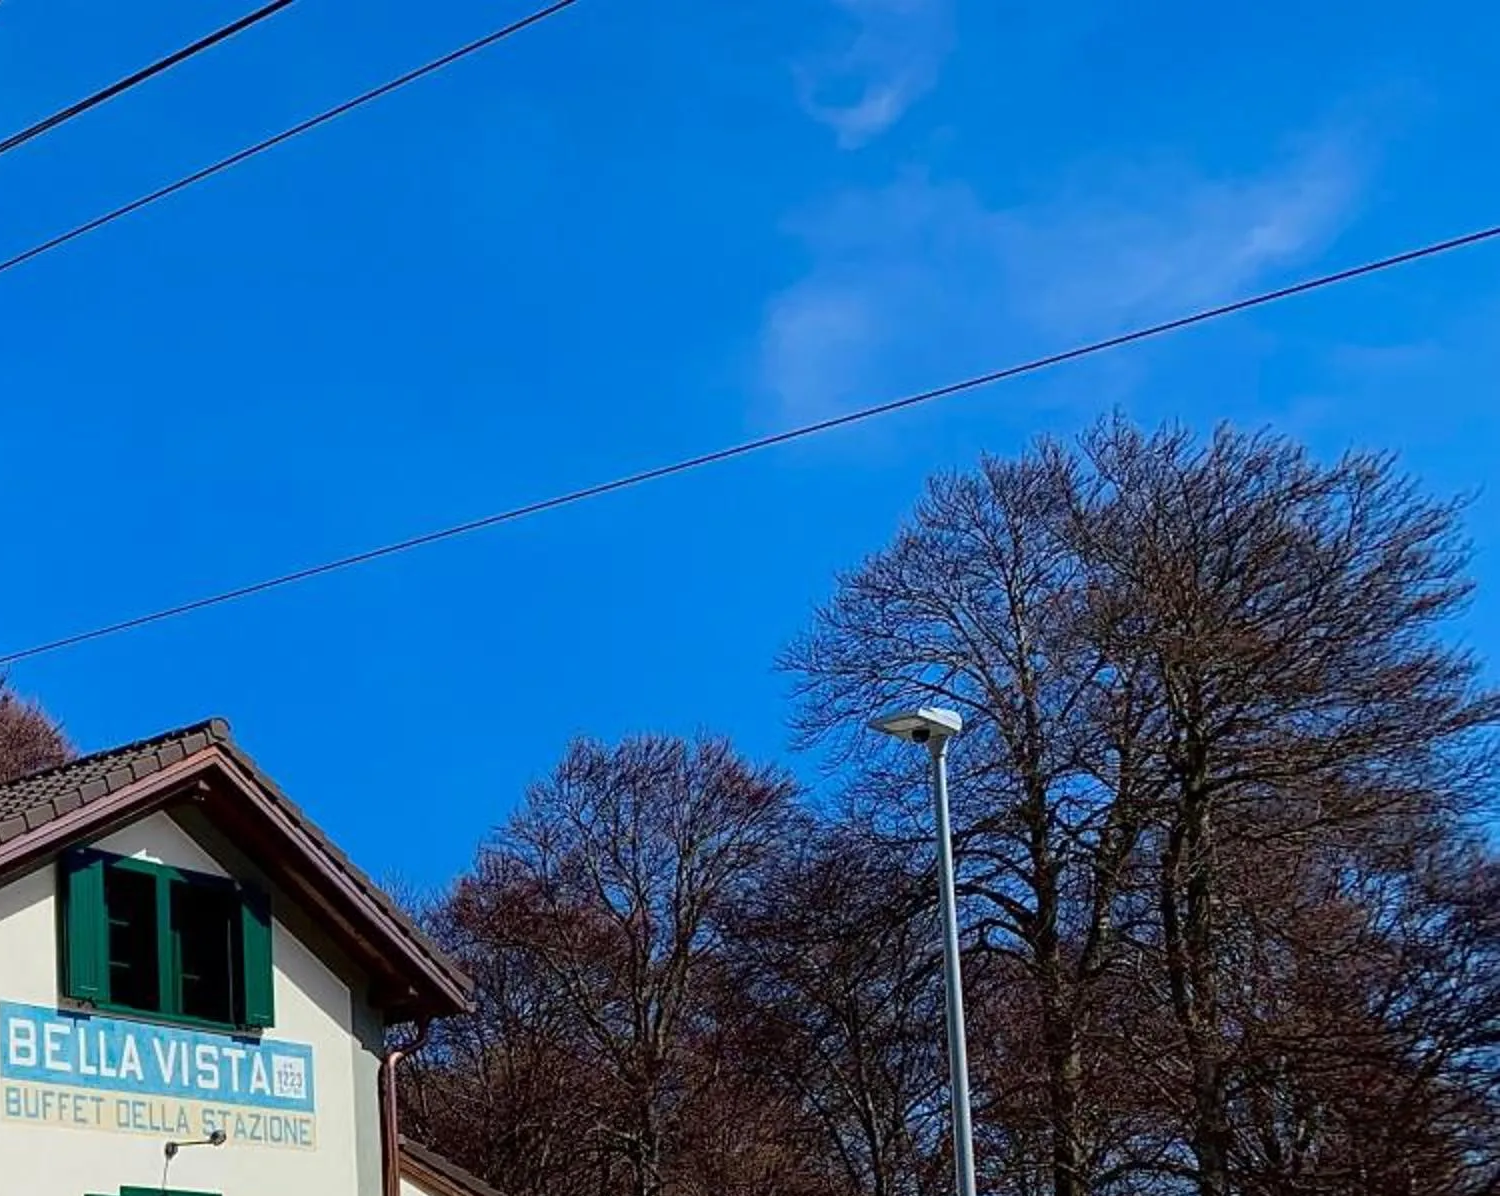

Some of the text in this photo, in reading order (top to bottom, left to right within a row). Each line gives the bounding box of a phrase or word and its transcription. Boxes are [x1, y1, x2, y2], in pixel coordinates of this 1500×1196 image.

[5, 1087, 312, 1145] BUFFET DELLA STAZIONE
